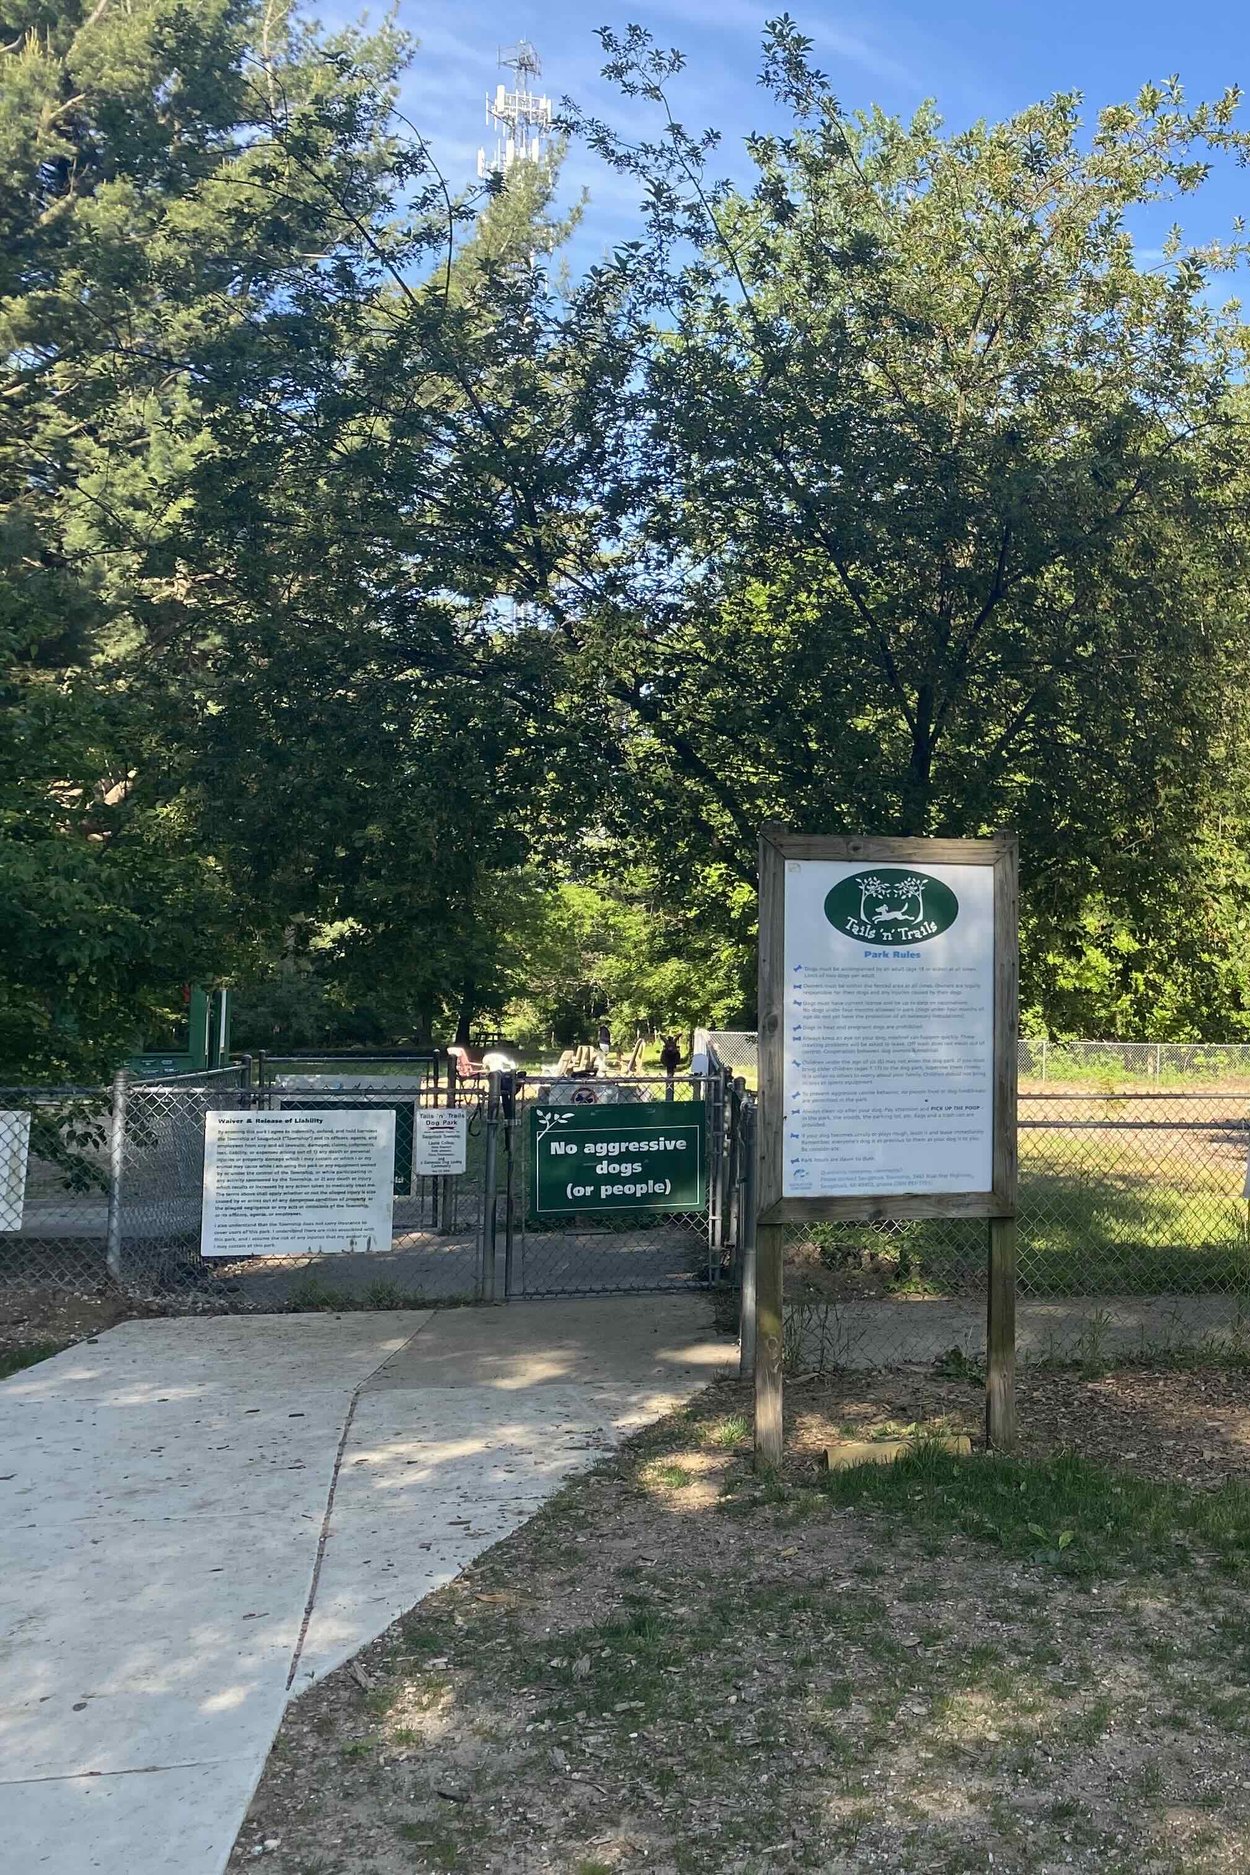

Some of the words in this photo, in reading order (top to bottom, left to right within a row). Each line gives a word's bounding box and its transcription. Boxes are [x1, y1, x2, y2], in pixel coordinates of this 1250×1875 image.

[845, 916, 876, 939] Tails
[898, 921, 938, 940] Trails
[864, 950, 890, 959] Park
[892, 950, 921, 959] Rules
[550, 1141, 578, 1155] No
[584, 1137, 687, 1157] aggressive
[596, 1160, 642, 1177] dogs
[566, 1183, 594, 1199] (or
[600, 1179, 672, 1198] people)
